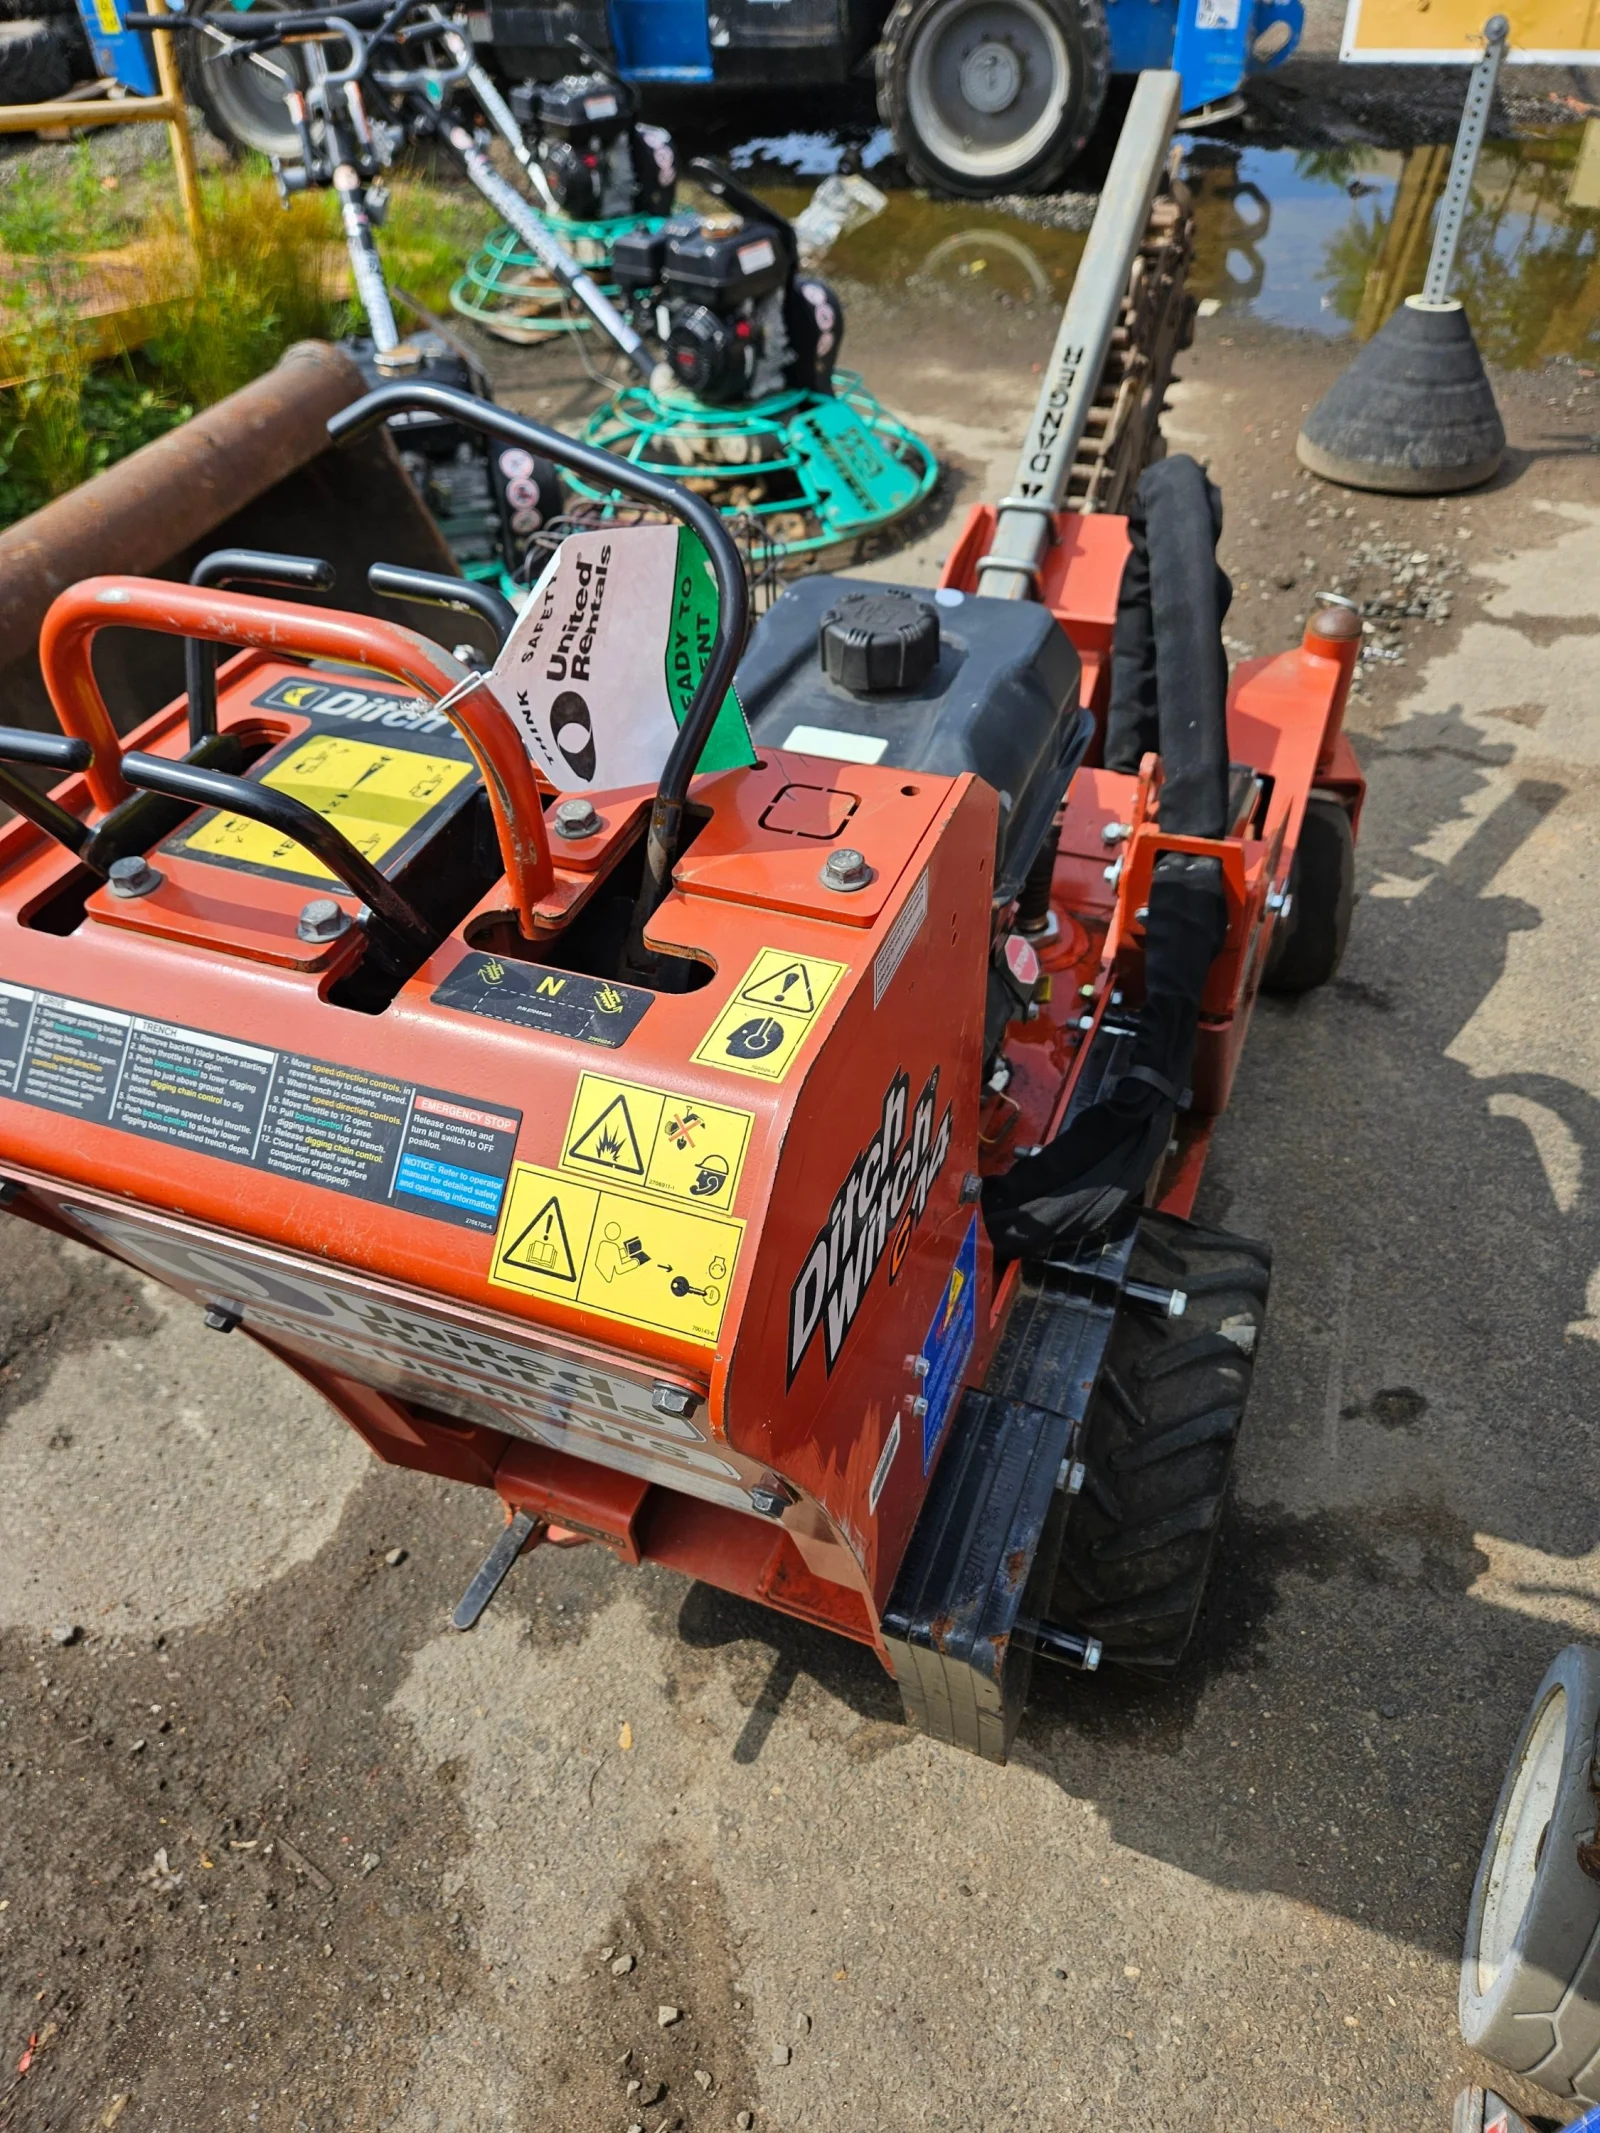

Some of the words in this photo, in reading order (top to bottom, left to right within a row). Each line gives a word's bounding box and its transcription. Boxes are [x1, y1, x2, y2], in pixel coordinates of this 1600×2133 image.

[1030, 346, 1084, 473] DANGER
[570, 544, 612, 682] Rentals
[679, 576, 692, 619] TO
[546, 562, 593, 682] United
[675, 632, 695, 711] EADY
[312, 691, 450, 733] Ditch
[517, 689, 554, 766] THINK
[536, 976, 566, 997] N
[142, 1021, 177, 1037] TRENCH
[129, 1042, 137, 1050] 2.
[137, 1044, 157, 1055] Move
[157, 1049, 183, 1062] throttle
[183, 1056, 191, 1064] to
[203, 1062, 224, 1074] open.
[132, 1032, 140, 1040] 1.
[139, 1034, 168, 1047] Remove
[168, 1041, 194, 1054] backfill
[194, 1048, 215, 1059] blade
[215, 1053, 238, 1065] before
[238, 1059, 269, 1075] starting.
[127, 1051, 135, 1060] 3.
[135, 1053, 153, 1064] Push
[154, 1058, 174, 1070] boom
[174, 1064, 199, 1077] control
[200, 1070, 208, 1079] to
[208, 1073, 228, 1084] lower
[228, 1078, 256, 1093] digging
[132, 1063, 153, 1075] boom
[153, 1069, 161, 1077] to
[161, 1071, 175, 1082] just
[176, 1075, 197, 1087] above
[197, 1080, 226, 1096] ground.
[277, 1075, 285, 1084] 8.
[286, 1078, 307, 1090] When
[307, 1083, 331, 1096] trench
[332, 1089, 340, 1098] is
[282, 1056, 290, 1064] 7.
[290, 1058, 311, 1069] Move
[311, 1063, 334, 1077] speed
[335, 1069, 368, 1084] direction
[403, 1086, 411, 1095] in
[122, 1071, 130, 1079] 4.
[130, 1073, 150, 1084] Move
[150, 1078, 177, 1093] digging
[177, 1086, 197, 1097] chain
[197, 1091, 222, 1104] control
[223, 1098, 231, 1106] to
[231, 1100, 244, 1111] dig
[128, 1083, 158, 1099] position.
[283, 1088, 311, 1101] release
[311, 1095, 334, 1109] speed
[335, 1101, 369, 1116] direction
[318, 1076, 343, 1090] slowly
[343, 1082, 352, 1090] to
[352, 1084, 381, 1098] desired
[381, 1092, 407, 1106] speed.
[115, 1101, 123, 1109] 6.
[123, 1103, 142, 1114] Push
[142, 1108, 162, 1120] boom
[163, 1114, 188, 1127] control
[188, 1121, 196, 1129] to
[196, 1123, 219, 1137] slowly
[220, 1129, 240, 1141] lower
[118, 1091, 126, 1099] 5.
[126, 1093, 155, 1107] Increase
[155, 1101, 180, 1115] engine
[180, 1108, 202, 1122] speed
[203, 1114, 211, 1122] to
[211, 1116, 223, 1126] full
[224, 1120, 252, 1134] throttle.
[267, 1104, 278, 1113] 10.
[279, 1107, 294, 1117] Pull
[294, 1111, 316, 1123] boom
[316, 1117, 343, 1130] control
[343, 1124, 352, 1133] to
[352, 1126, 372, 1138] raise
[272, 1095, 281, 1104] 9.
[281, 1098, 301, 1109] Move
[302, 1103, 329, 1117] throttle
[329, 1110, 338, 1119] to
[351, 1117, 373, 1130] open.
[413, 1114, 444, 1129] Release
[445, 1122, 477, 1137] controls
[478, 1130, 494, 1141] and
[420, 1099, 482, 1122] EMERGENCY
[484, 1115, 511, 1129] STOP
[121, 1113, 147, 1128] digging
[148, 1120, 168, 1132] boom
[168, 1126, 177, 1135] to
[177, 1129, 204, 1142] desired
[204, 1136, 227, 1149] trench
[227, 1142, 251, 1157] depth.
[260, 1134, 272, 1143] 12.
[272, 1137, 294, 1149] Close
[294, 1143, 309, 1153] fuel
[309, 1147, 336, 1160] shutoff
[336, 1154, 356, 1166] valve
[357, 1160, 365, 1168] at
[262, 1124, 274, 1133] 11.
[274, 1127, 304, 1141] Release
[304, 1135, 332, 1151] digging
[333, 1143, 354, 1155] chain
[354, 1148, 384, 1163] control.
[276, 1117, 304, 1133] digging
[305, 1125, 326, 1137] boom
[327, 1130, 336, 1139] to
[336, 1133, 349, 1145] top
[350, 1137, 359, 1145] of
[359, 1139, 386, 1153] trench.
[407, 1135, 442, 1152] position.
[410, 1124, 427, 1135] turn
[427, 1129, 440, 1139] kill
[440, 1132, 466, 1146] switch
[467, 1139, 476, 1148] to
[476, 1141, 494, 1153] OFF
[267, 1156, 301, 1174] transport
[301, 1166, 310, 1176] (if
[269, 1147, 310, 1166] completion
[311, 1158, 319, 1167] of
[319, 1160, 332, 1172] job
[333, 1165, 342, 1173] or
[342, 1166, 368, 1180] before
[403, 1156, 437, 1172] NOTICE:
[437, 1165, 459, 1178] Refer
[459, 1171, 468, 1180] to
[468, 1174, 502, 1192] operator
[399, 1177, 413, 1188] and
[414, 1181, 450, 1200] operating
[451, 1191, 497, 1211] information.
[401, 1167, 429, 1181] manual
[430, 1174, 442, 1184] for
[442, 1178, 473, 1193] detailed
[473, 1186, 498, 1202] safety
[792, 1086, 906, 1371] Ditch
[827, 1098, 933, 1363] Witch
[324, 1291, 613, 1396] United
[359, 1317, 665, 1425] Rentals
